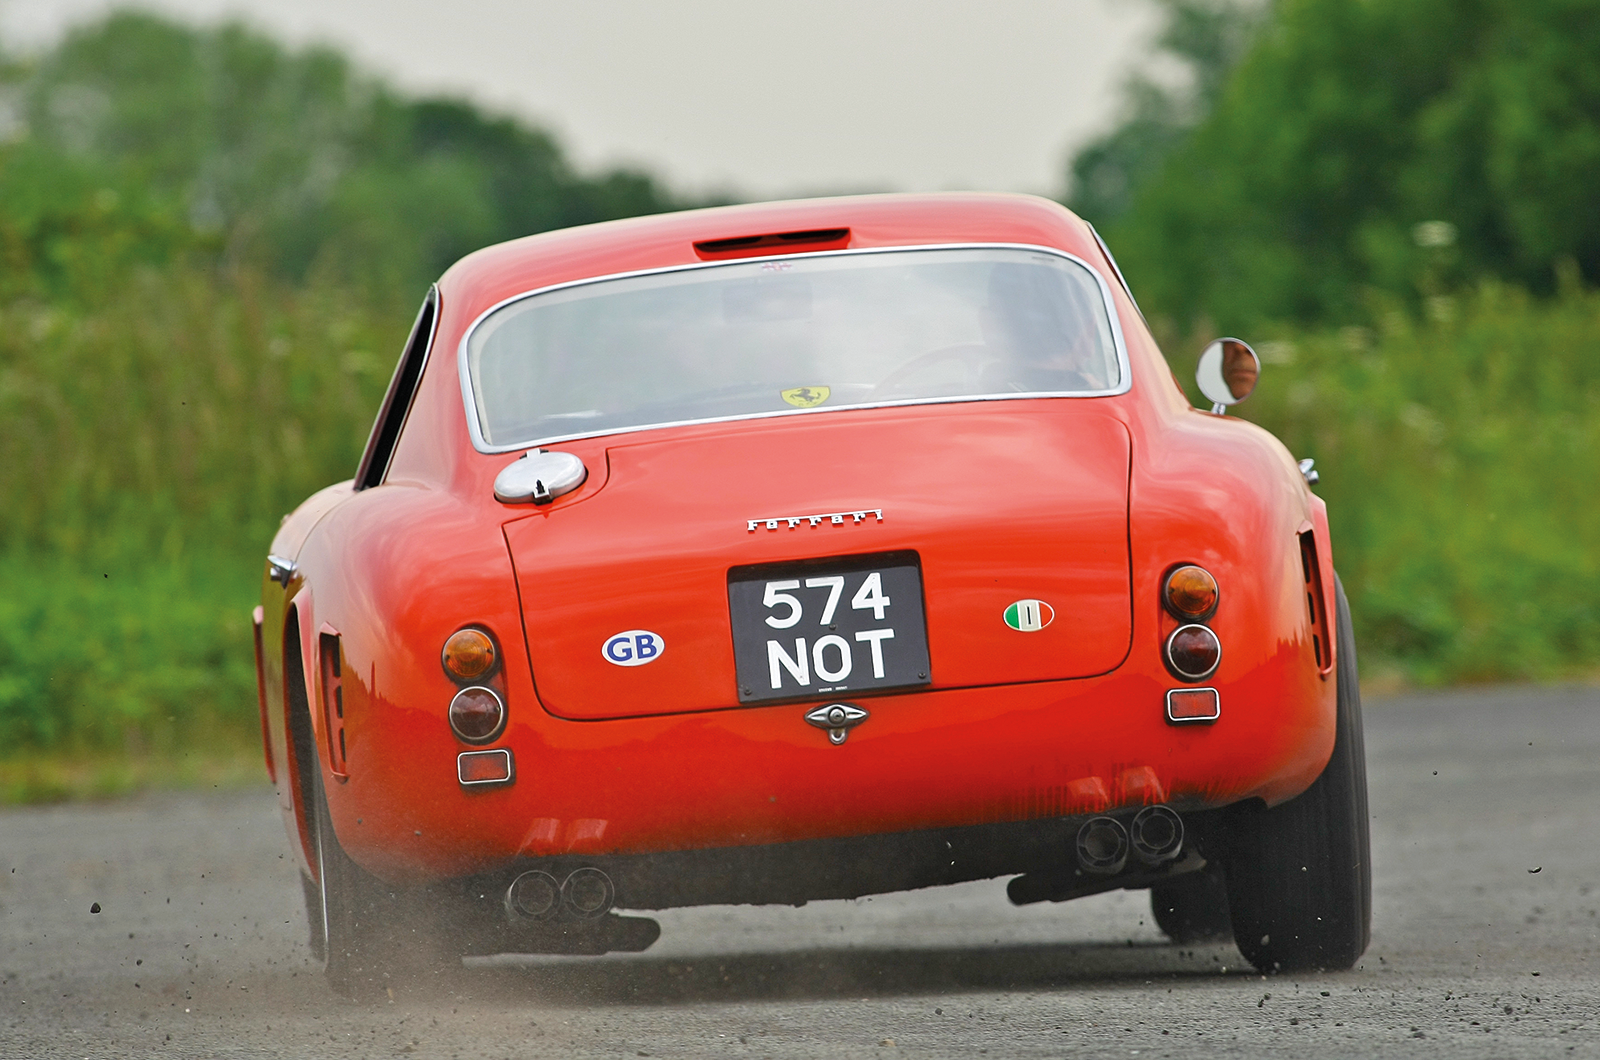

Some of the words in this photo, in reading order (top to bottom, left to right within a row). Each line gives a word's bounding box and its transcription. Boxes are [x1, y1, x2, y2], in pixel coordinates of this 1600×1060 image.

[747, 509, 883, 531] Ferrari
[763, 572, 891, 630] 574
[606, 634, 658, 662] GB
[767, 628, 895, 689] NOT
